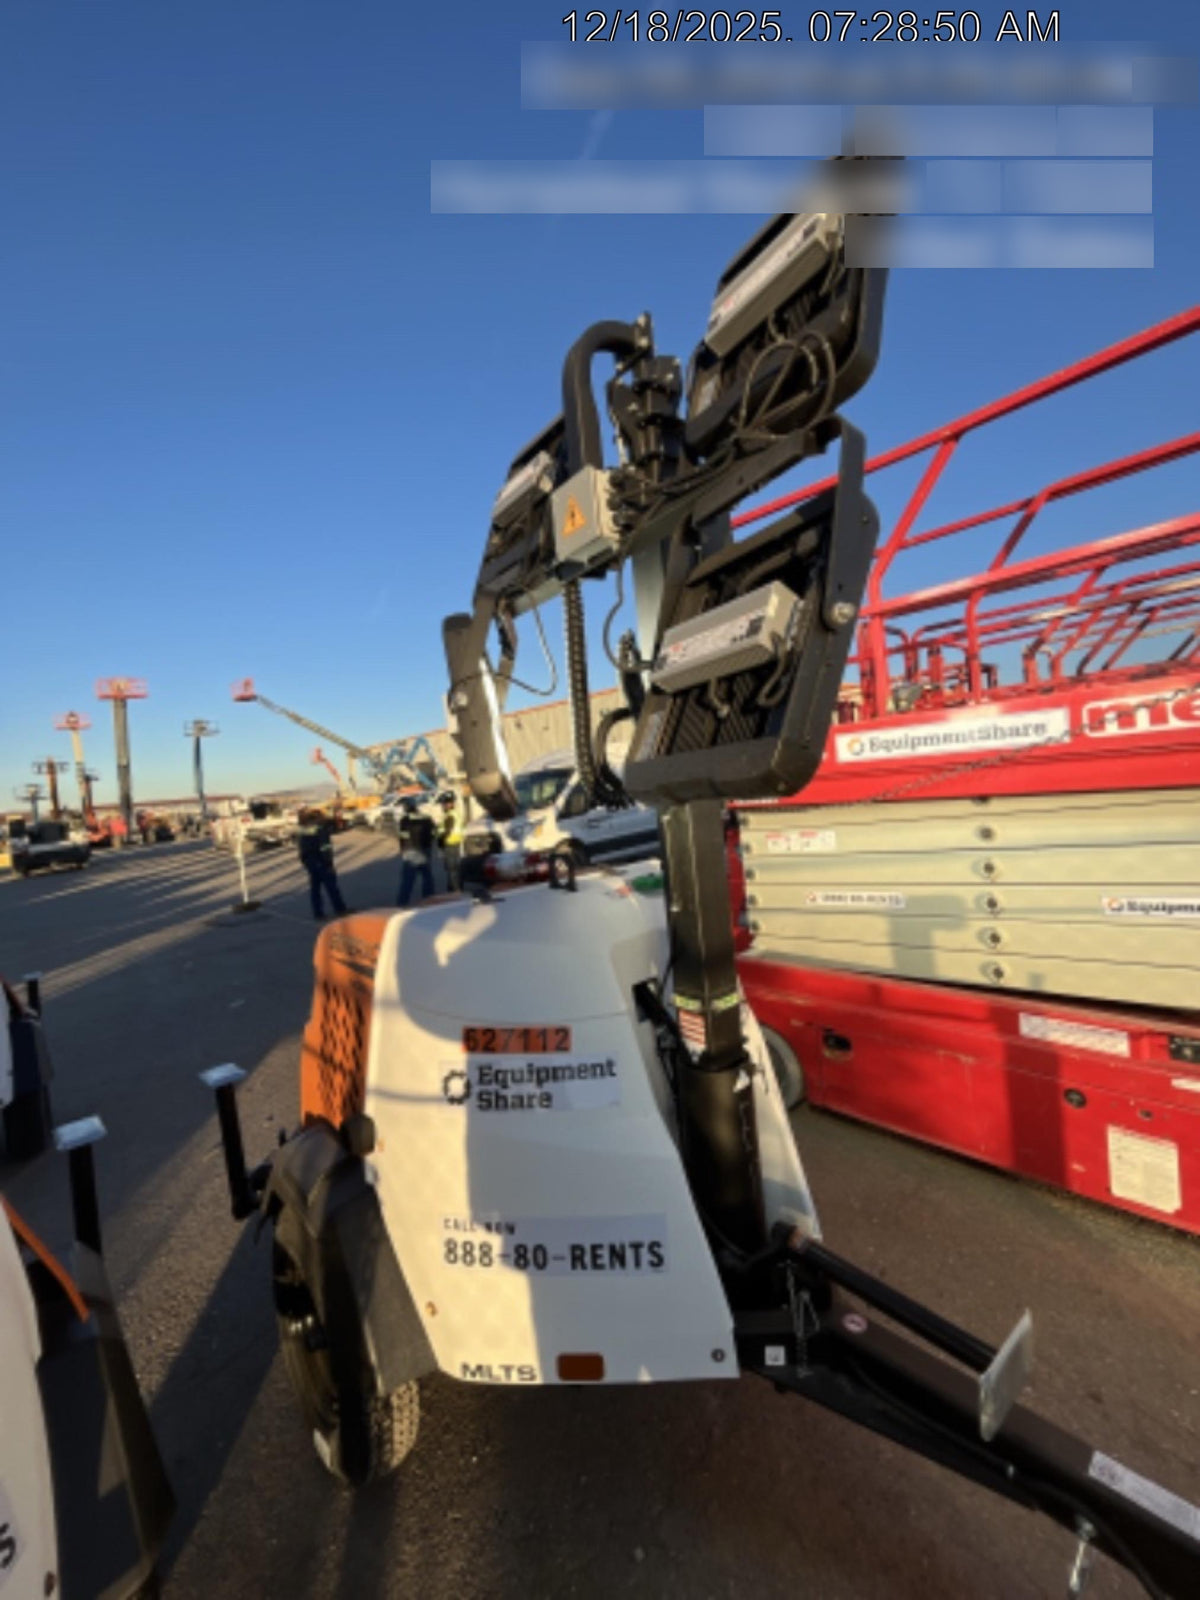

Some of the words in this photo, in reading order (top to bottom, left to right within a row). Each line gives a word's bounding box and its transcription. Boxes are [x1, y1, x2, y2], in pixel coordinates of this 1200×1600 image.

[869, 722, 1047, 752] EquipmentShare
[463, 1027, 571, 1052] 627112
[477, 1058, 617, 1089] Equipment
[477, 1089, 553, 1111] Share
[444, 1218, 476, 1232] CALL
[443, 1238, 664, 1271] 888-80-RENTS
